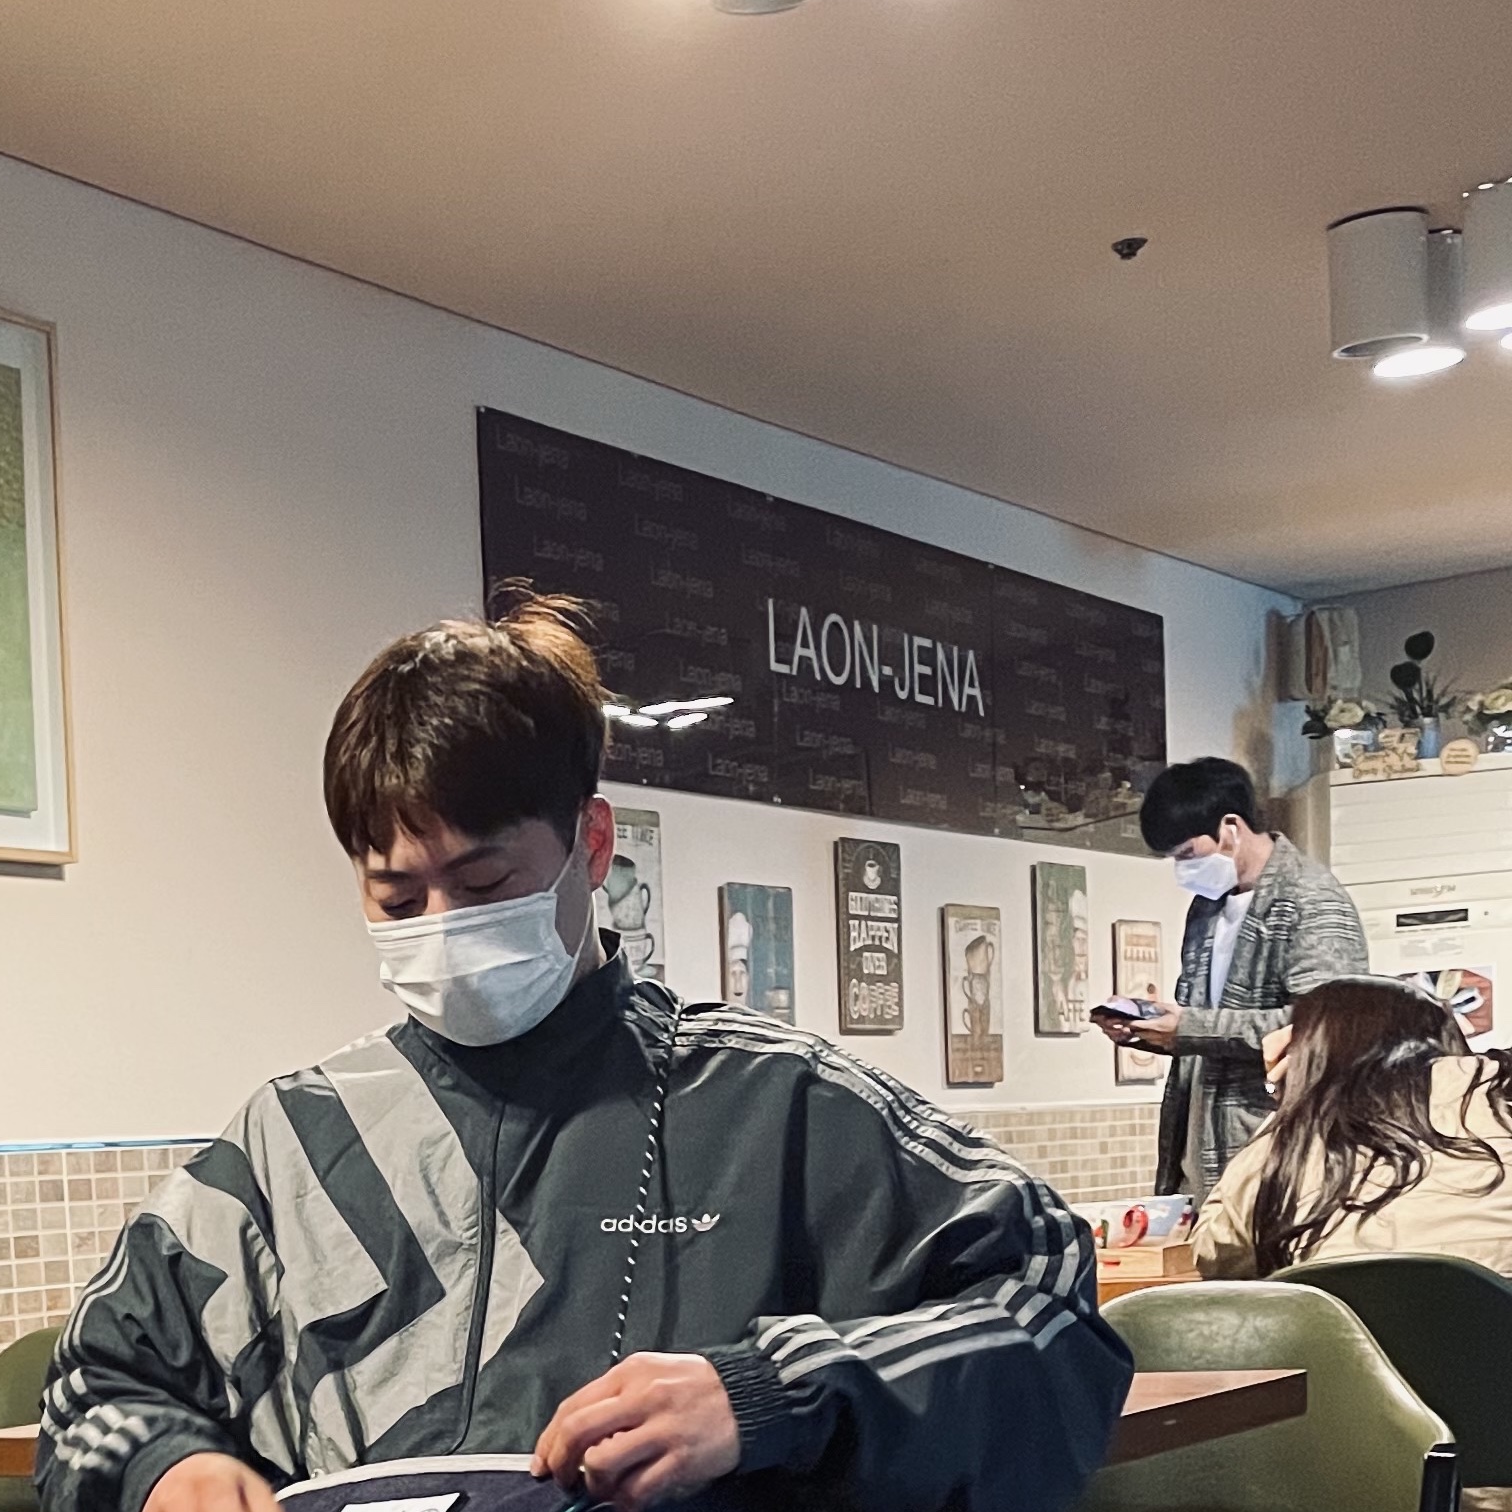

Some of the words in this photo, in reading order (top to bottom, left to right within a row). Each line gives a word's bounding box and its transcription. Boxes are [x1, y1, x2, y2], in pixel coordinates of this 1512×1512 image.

[767, 597, 985, 717] LAON-JENA
[849, 978, 900, 1019] COFFEE
[600, 1214, 688, 1234] addas
